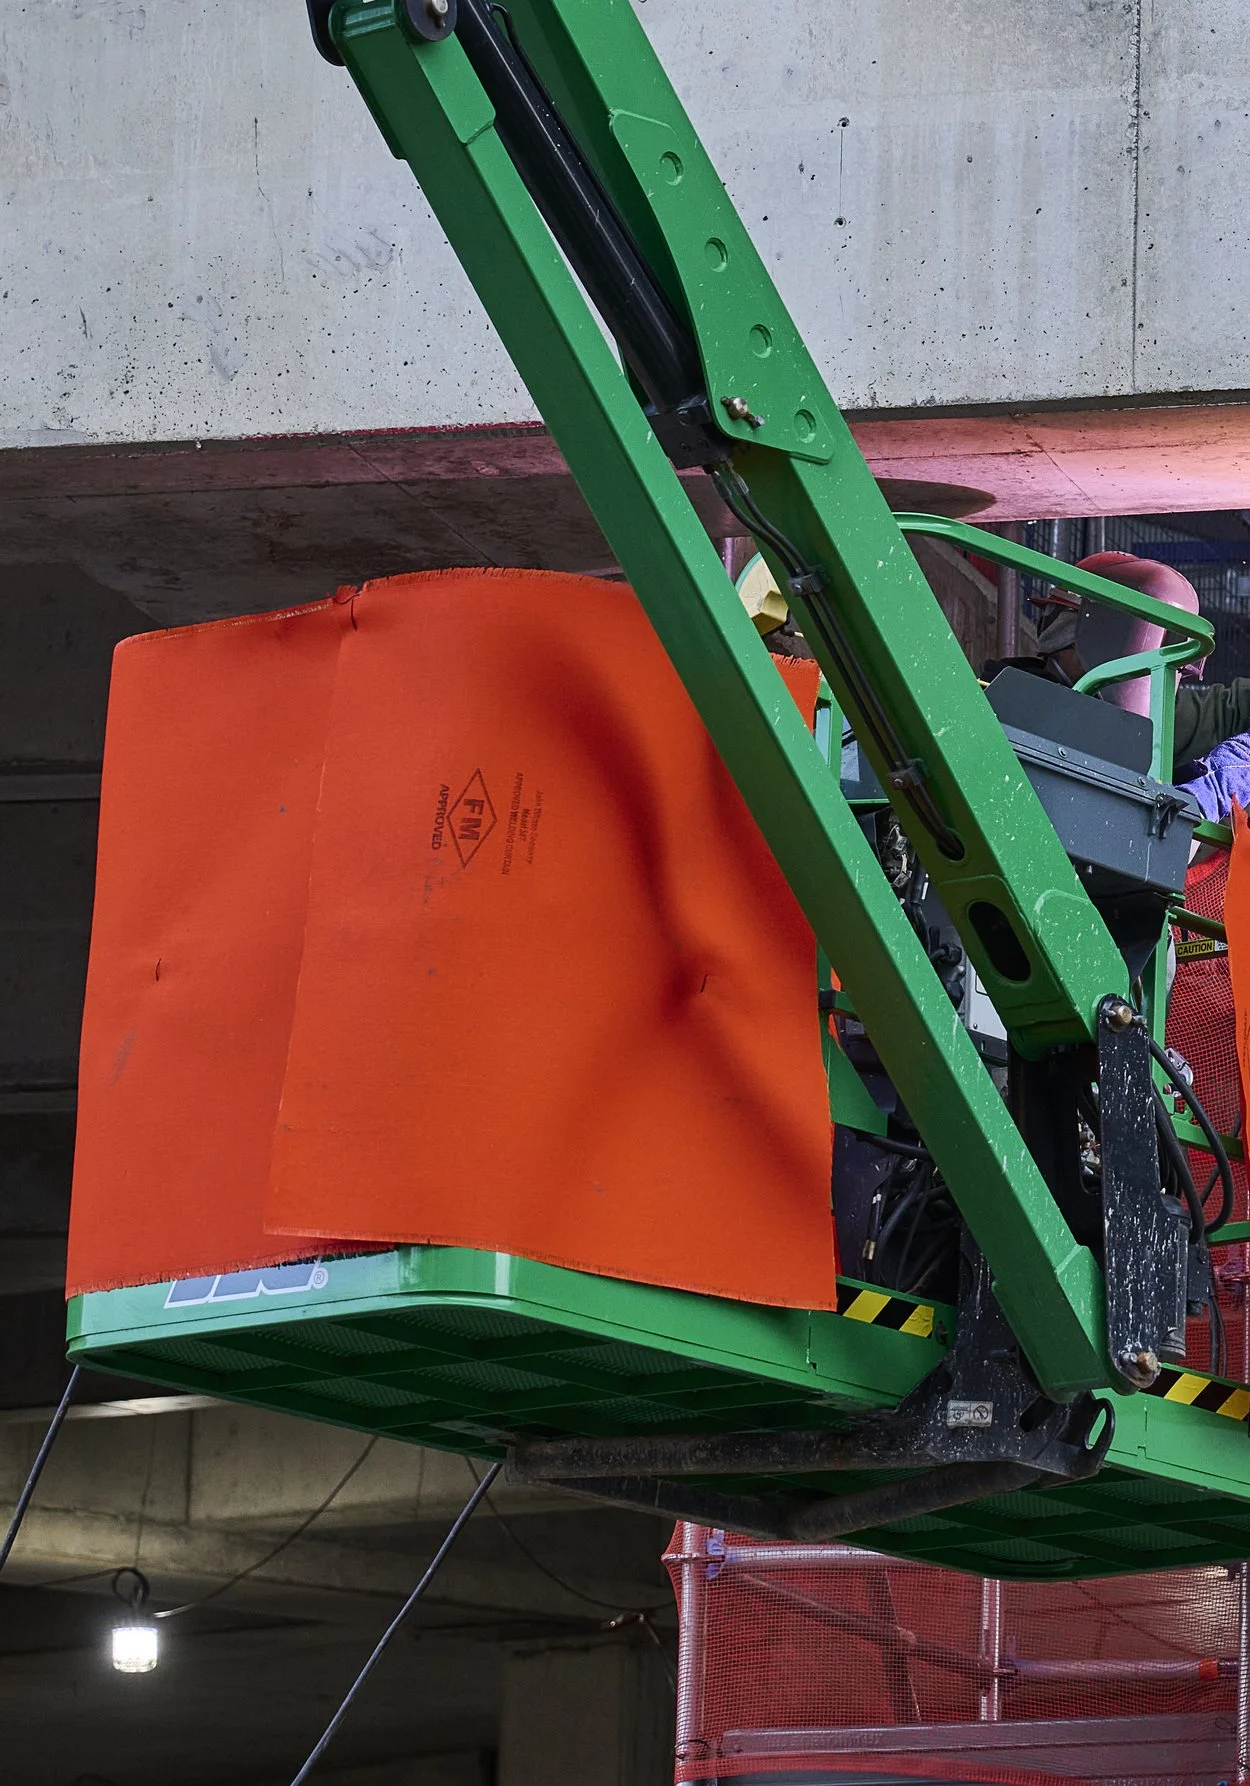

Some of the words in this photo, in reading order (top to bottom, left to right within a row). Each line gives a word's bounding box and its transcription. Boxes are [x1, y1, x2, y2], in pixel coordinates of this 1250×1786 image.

[512, 771, 524, 810] APPROVED
[432, 784, 450, 850] APPROVED
[459, 798, 484, 840] FM
[507, 811, 519, 843] WELDING
[502, 844, 514, 875] CURTAIN
[1177, 941, 1213, 956] CAUTION
